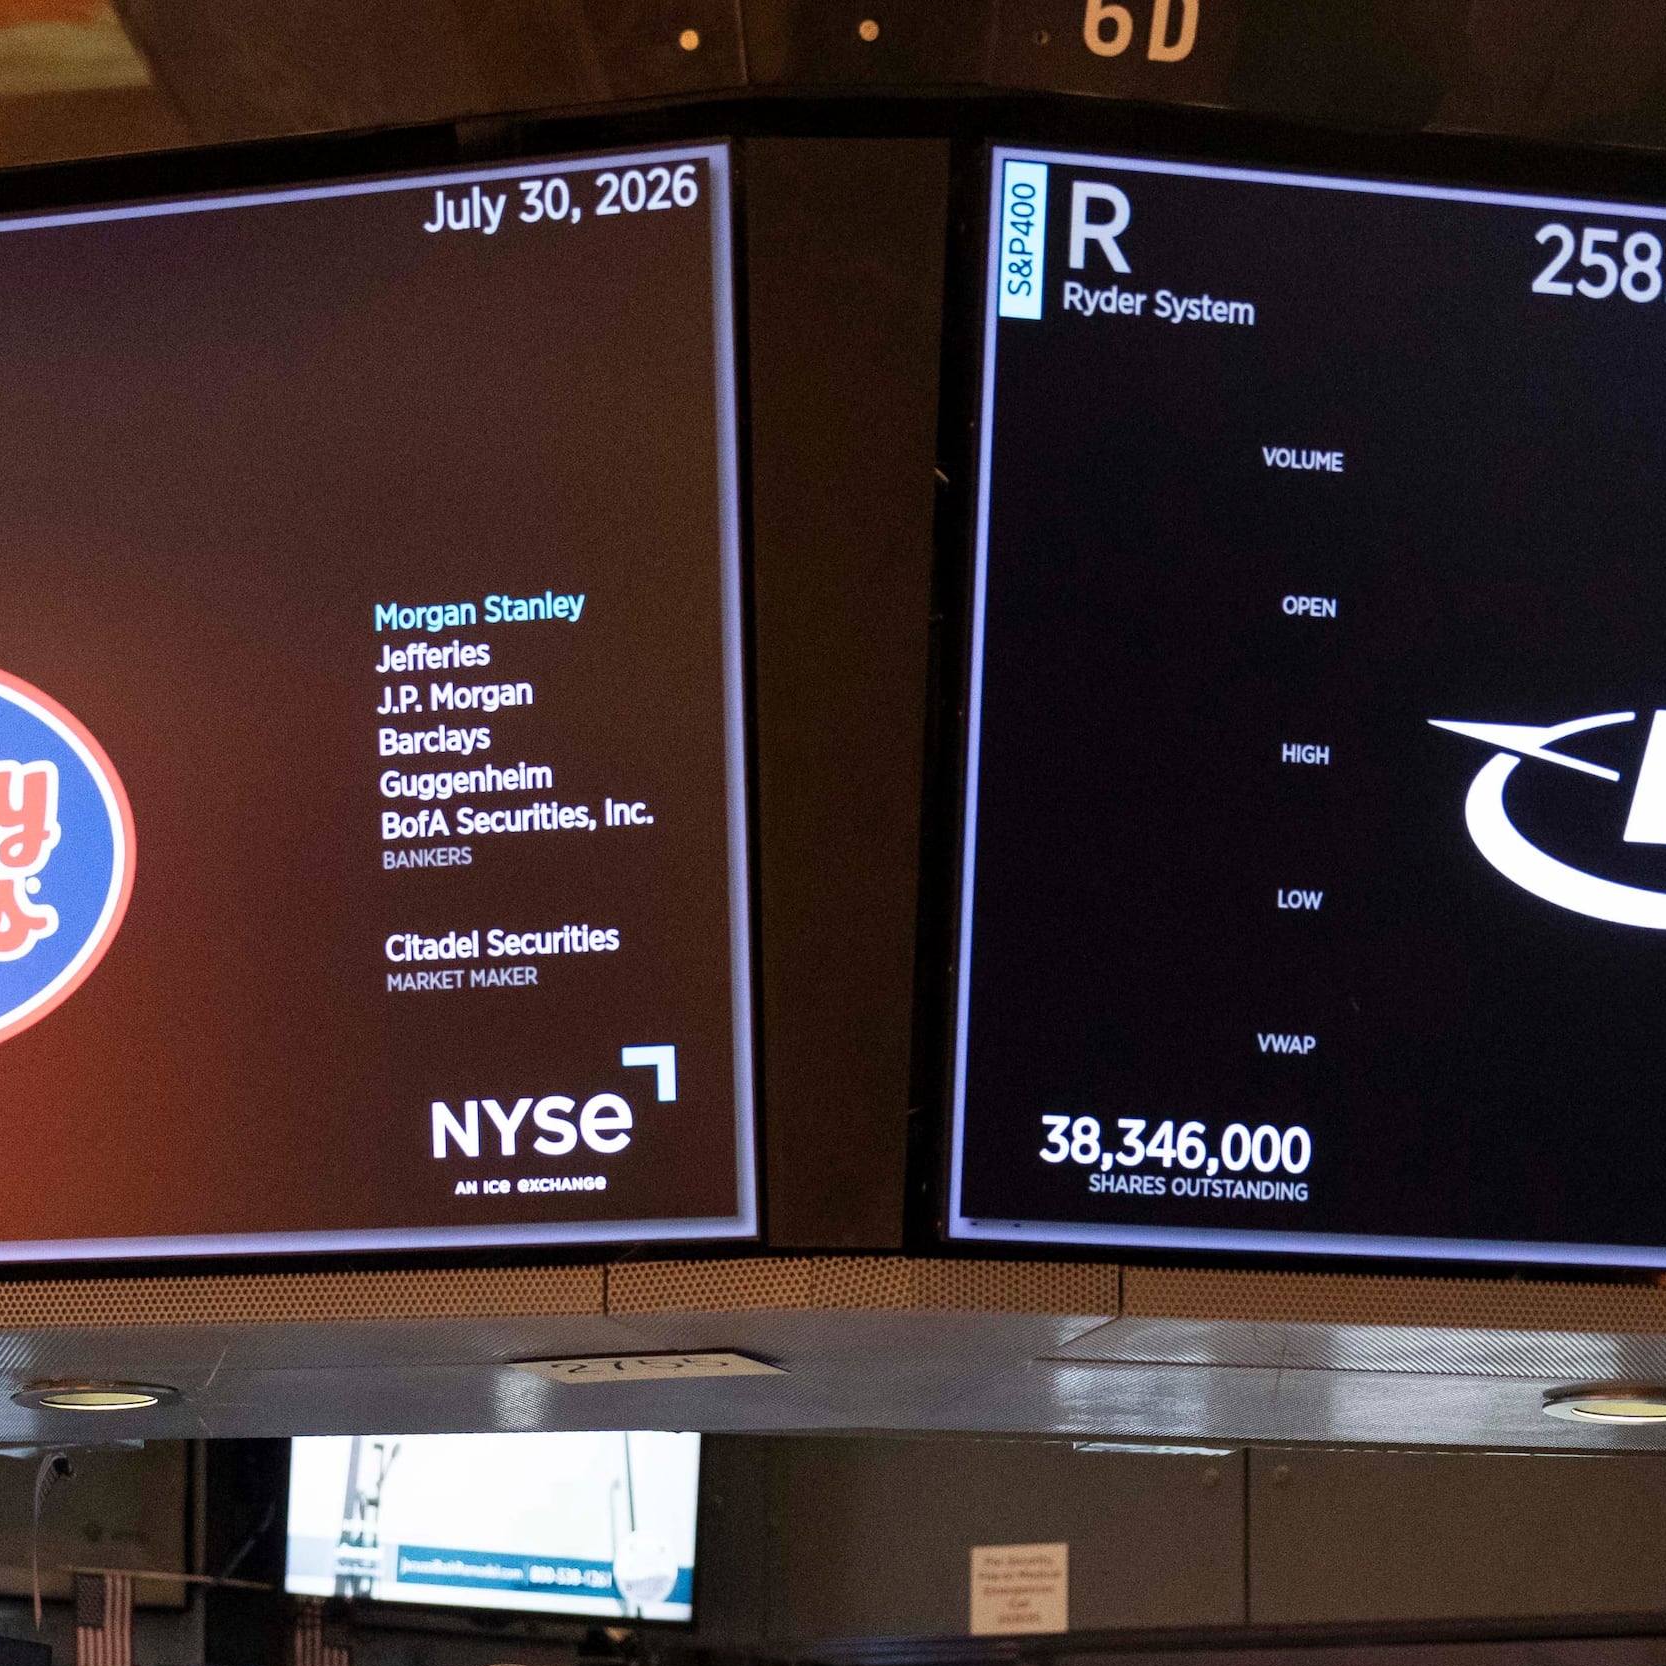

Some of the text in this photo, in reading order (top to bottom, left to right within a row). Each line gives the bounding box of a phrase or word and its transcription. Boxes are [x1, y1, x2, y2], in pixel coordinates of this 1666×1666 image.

[424, 165, 698, 234] July 30, 2026
[1008, 183, 1035, 298] S&P400
[1070, 181, 1131, 273] R
[1064, 281, 1255, 325] Ryder System
[1263, 447, 1343, 472] VOLUME
[375, 591, 585, 632] Morgan Stanley
[1283, 596, 1336, 617] OPEN
[376, 640, 490, 672] Jefferies
[377, 682, 533, 714] J.P. Morgan
[379, 724, 491, 756] Barclays
[1283, 744, 1329, 764] HIGH
[380, 762, 552, 800] Guggenheim
[382, 798, 653, 839] BofA Securities, Inc.
[384, 847, 472, 869] BANKERS
[1278, 890, 1323, 909] LOW
[385, 924, 619, 961] Citadel Securities
[388, 967, 537, 991] MARKET MAKER
[1258, 1034, 1316, 1054] VWAP
[1040, 1115, 1311, 1176] 38,346,000
[1090, 1174, 1308, 1201] SHARES OUTSTANDING
